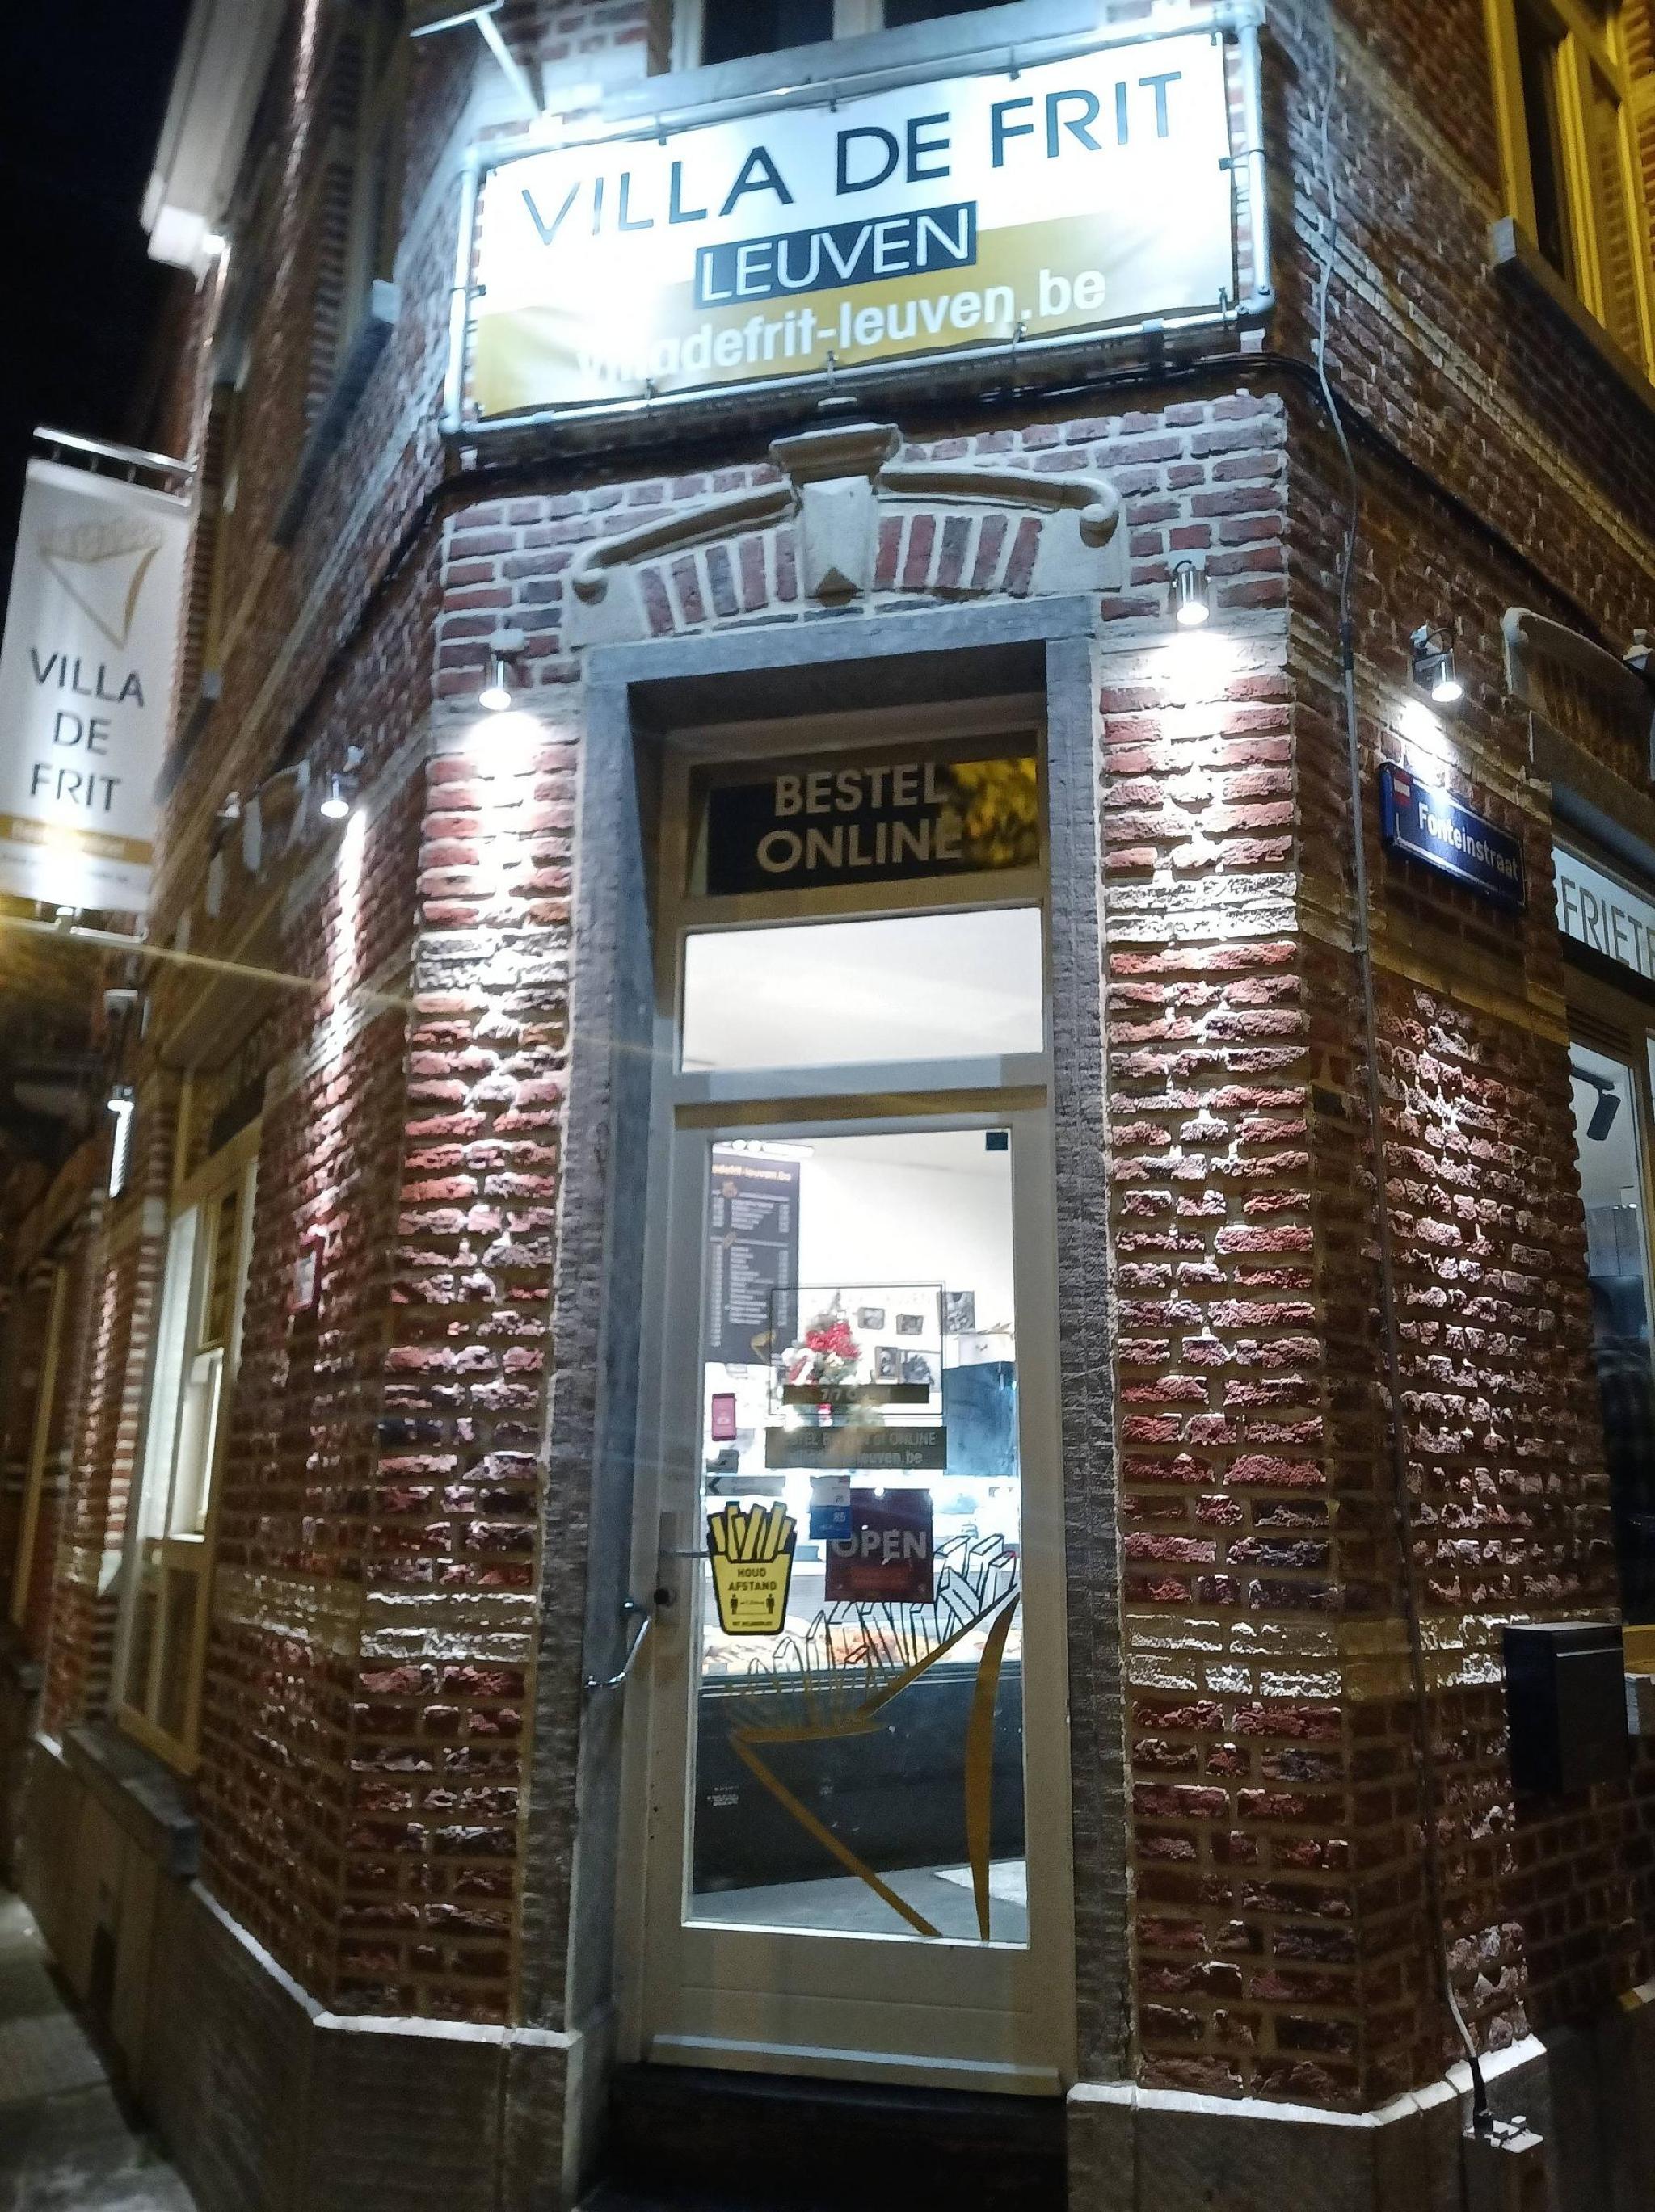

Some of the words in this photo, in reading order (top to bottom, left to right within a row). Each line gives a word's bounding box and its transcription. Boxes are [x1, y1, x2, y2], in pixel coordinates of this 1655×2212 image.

[521, 145, 793, 246] VILLA
[836, 111, 951, 196] DE
[991, 69, 1182, 168] FRIT
[699, 207, 970, 302] LEUVEN
[29, 647, 145, 708] VILLA
[52, 711, 112, 756] DE
[29, 762, 121, 812] FRIT
[774, 762, 949, 817] BESTEL
[756, 810, 963, 873] ONLINE
[1418, 801, 1519, 882] Fonteinstraat
[831, 1529, 927, 1559] OPEN
[727, 1580, 777, 1592] AFSTAND
[737, 1567, 767, 1578] HOUD
